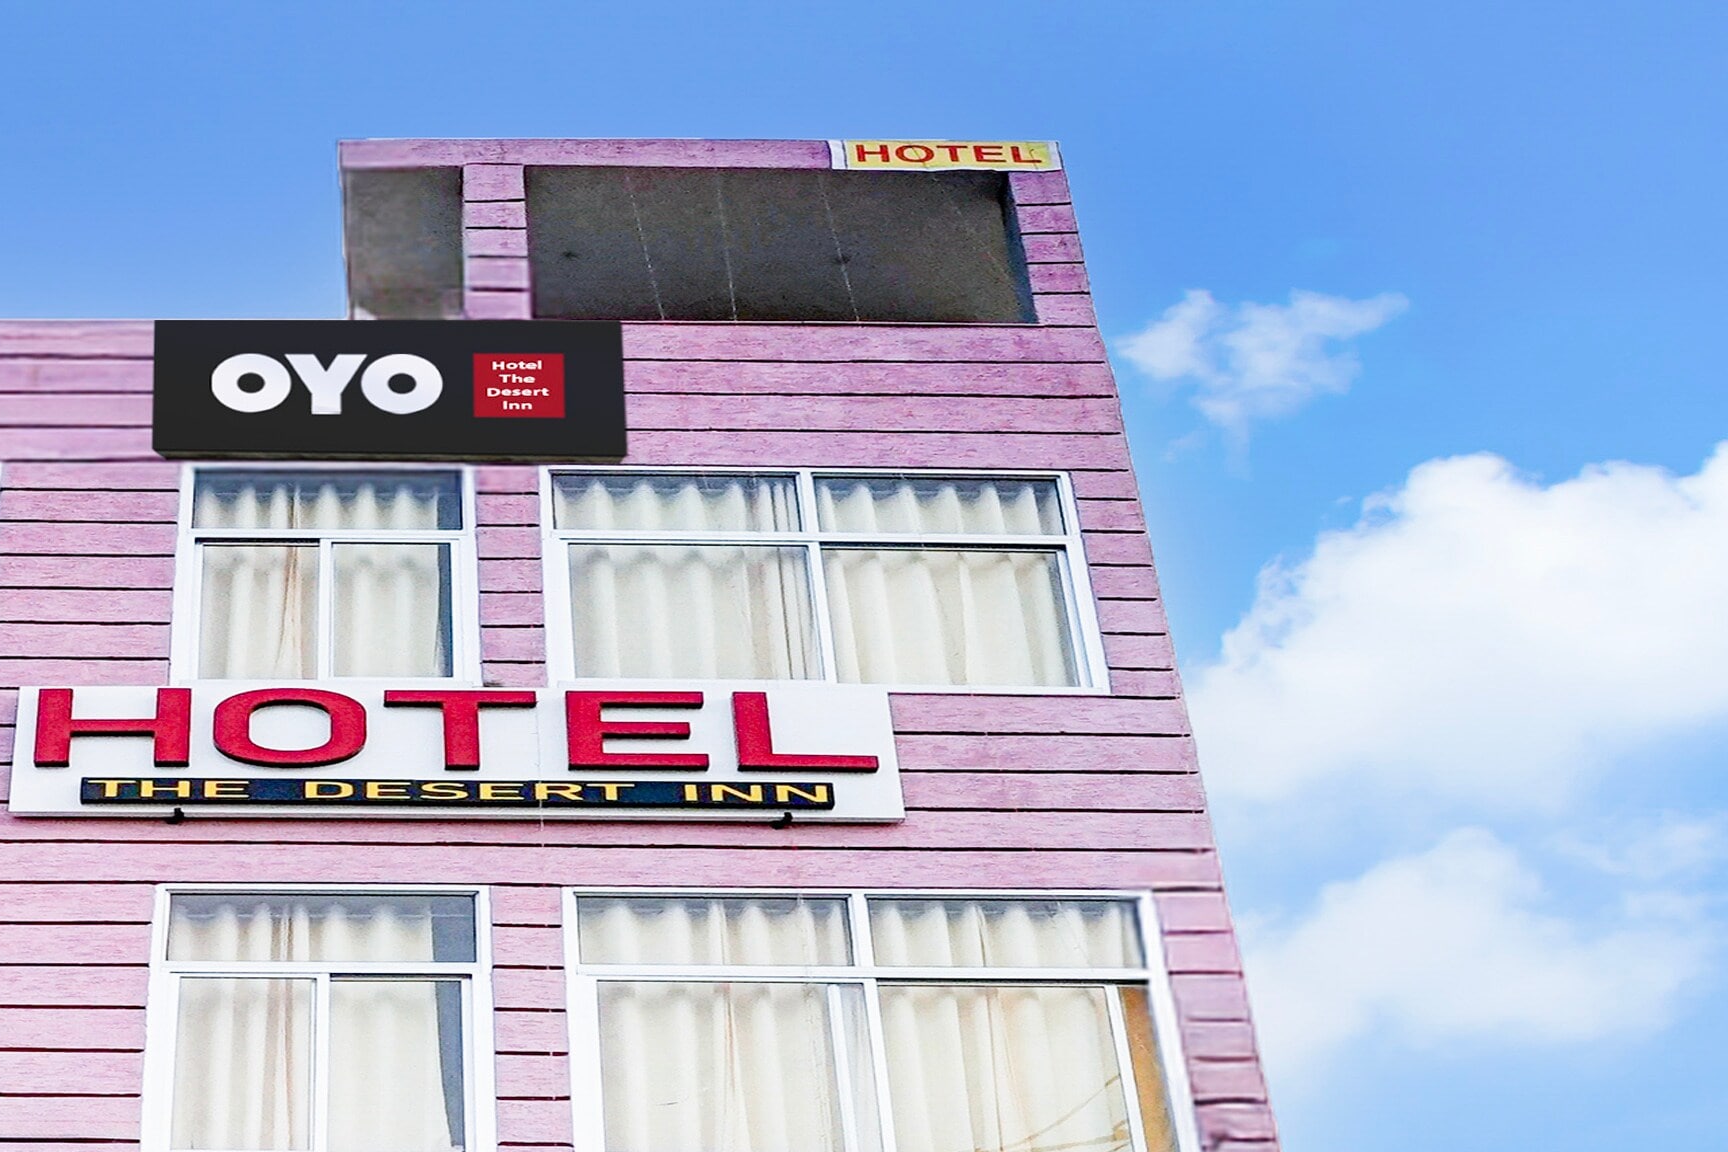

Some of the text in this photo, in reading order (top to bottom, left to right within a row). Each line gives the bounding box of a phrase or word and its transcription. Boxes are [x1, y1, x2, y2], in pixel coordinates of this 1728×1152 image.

[855, 144, 1043, 163] HOTEL
[491, 359, 543, 371] Hotel
[210, 352, 444, 415] OYO
[498, 373, 536, 384] The
[486, 387, 550, 397] Desert
[502, 400, 533, 410] Inn
[33, 687, 880, 772] HOTEL
[86, 779, 829, 803] THE DESERT INN
